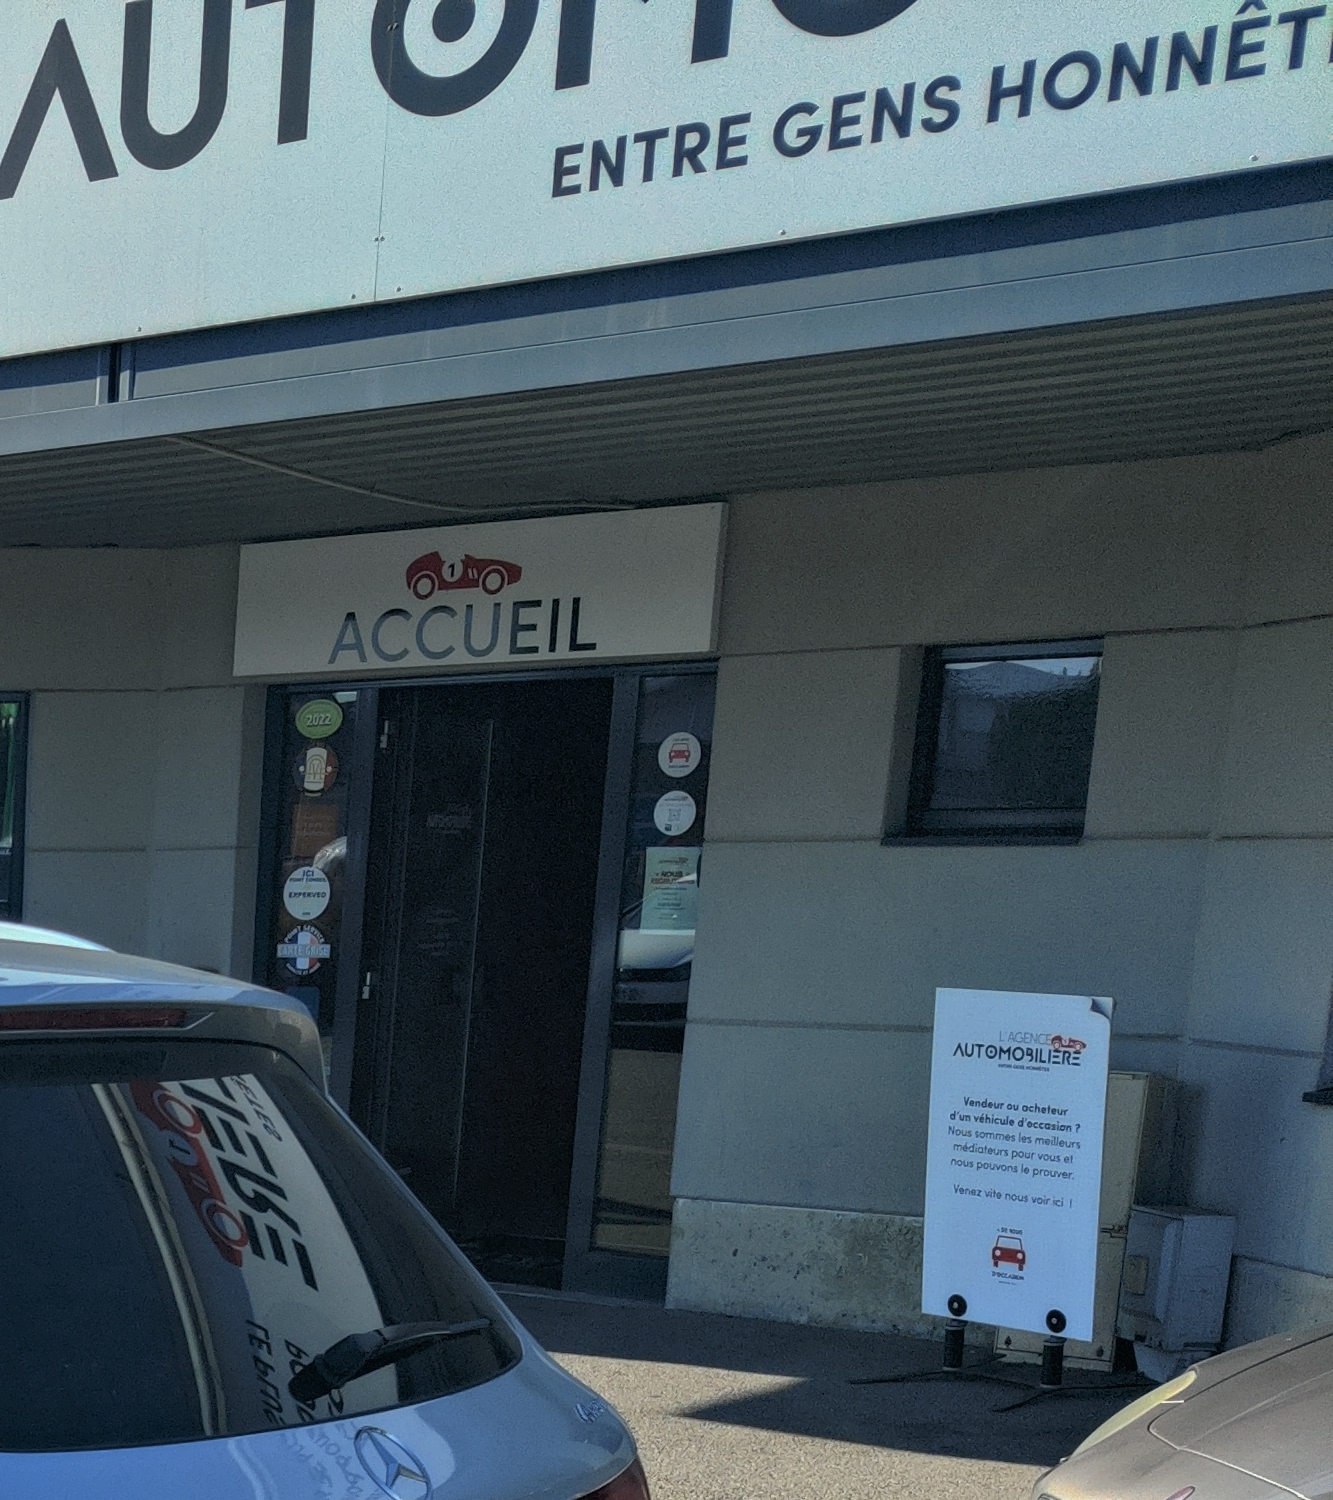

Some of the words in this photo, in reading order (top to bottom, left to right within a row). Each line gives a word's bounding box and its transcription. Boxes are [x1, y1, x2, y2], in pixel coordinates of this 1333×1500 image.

[552, 112, 752, 198] ENTRE
[772, 75, 962, 158] GENS
[986, 0, 1333, 124] HONNÊT
[447, 562, 456, 578] 1
[327, 596, 598, 665] ACCUEIL
[306, 713, 332, 728] 2022
[999, 1031, 1052, 1045] L'AGENCE
[963, 1097, 1004, 1109] Vendeur
[1007, 1102, 1019, 1111] ou
[1022, 1103, 1068, 1116] acheteur
[950, 1111, 971, 1122] d'un
[973, 1113, 1015, 1126] véhicule
[1018, 1117, 1072, 1132] d'occasion
[1075, 1123, 1081, 1133] ?
[948, 1126, 972, 1137] Nous
[975, 1130, 1016, 1142] sommes
[1018, 1132, 1032, 1143] les
[1034, 1136, 1081, 1149] meilleurs
[953, 1143, 1009, 1157] médiateurs
[1011, 1149, 1035, 1160] pour
[1037, 1152, 1060, 1163] vous
[1063, 1155, 1073, 1164] et
[950, 1158, 973, 1168] nous
[976, 1161, 1018, 1173] pouvons
[1021, 1164, 1030, 1174] le
[1032, 1168, 1074, 1180] prouver.
[953, 1184, 982, 1197] Venez
[985, 1187, 1002, 1199] vite
[1005, 1193, 1028, 1203] nous
[1031, 1195, 1050, 1206] voir
[1053, 1197, 1064, 1207] ici
